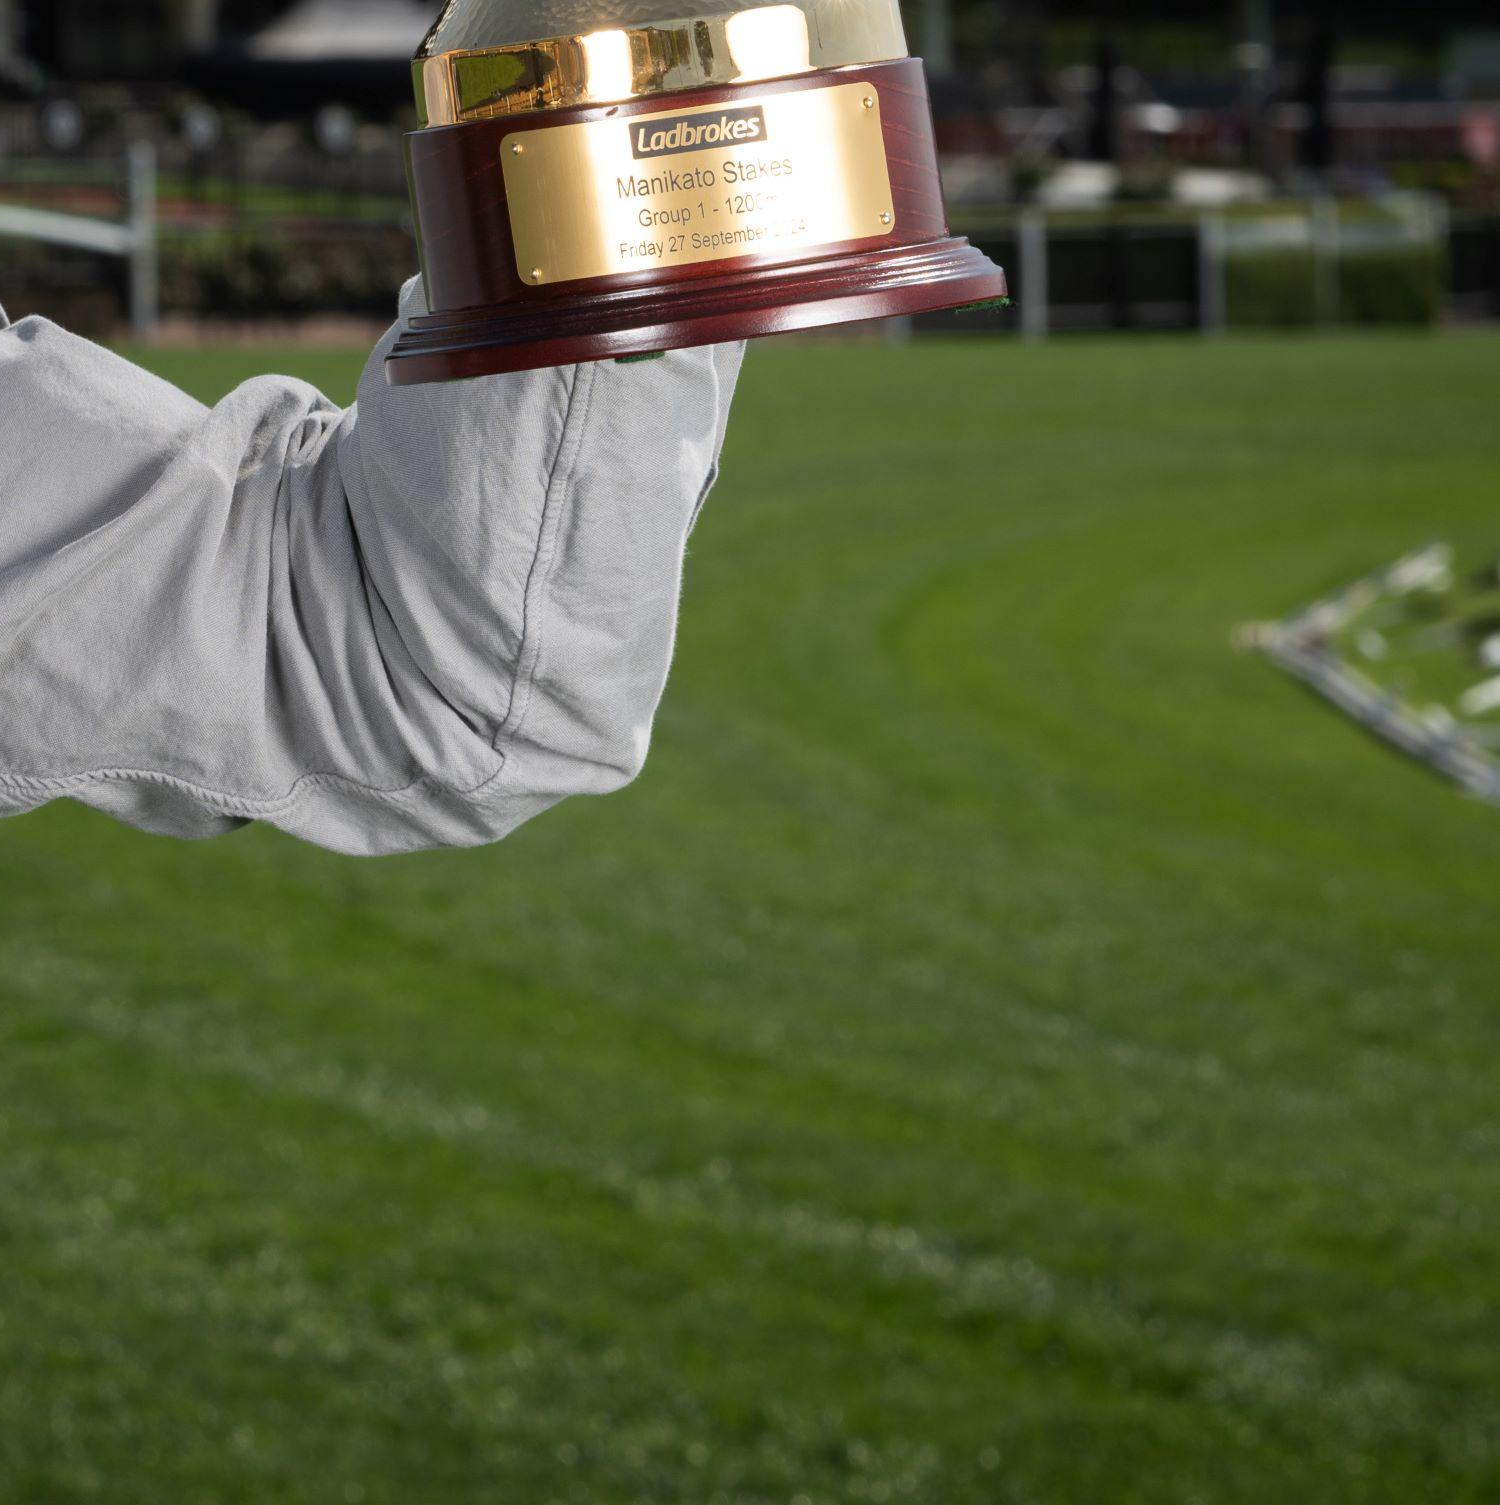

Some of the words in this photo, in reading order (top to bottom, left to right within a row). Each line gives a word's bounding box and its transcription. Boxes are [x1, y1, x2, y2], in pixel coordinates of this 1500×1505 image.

[637, 116, 760, 152] Ladbrokes
[617, 167, 715, 198] Manikato
[722, 157, 792, 184] Stakes
[638, 207, 691, 227] Group
[697, 201, 705, 219] 1
[725, 192, 779, 215] 120
[620, 240, 663, 258] Friday
[668, 235, 685, 252] 27
